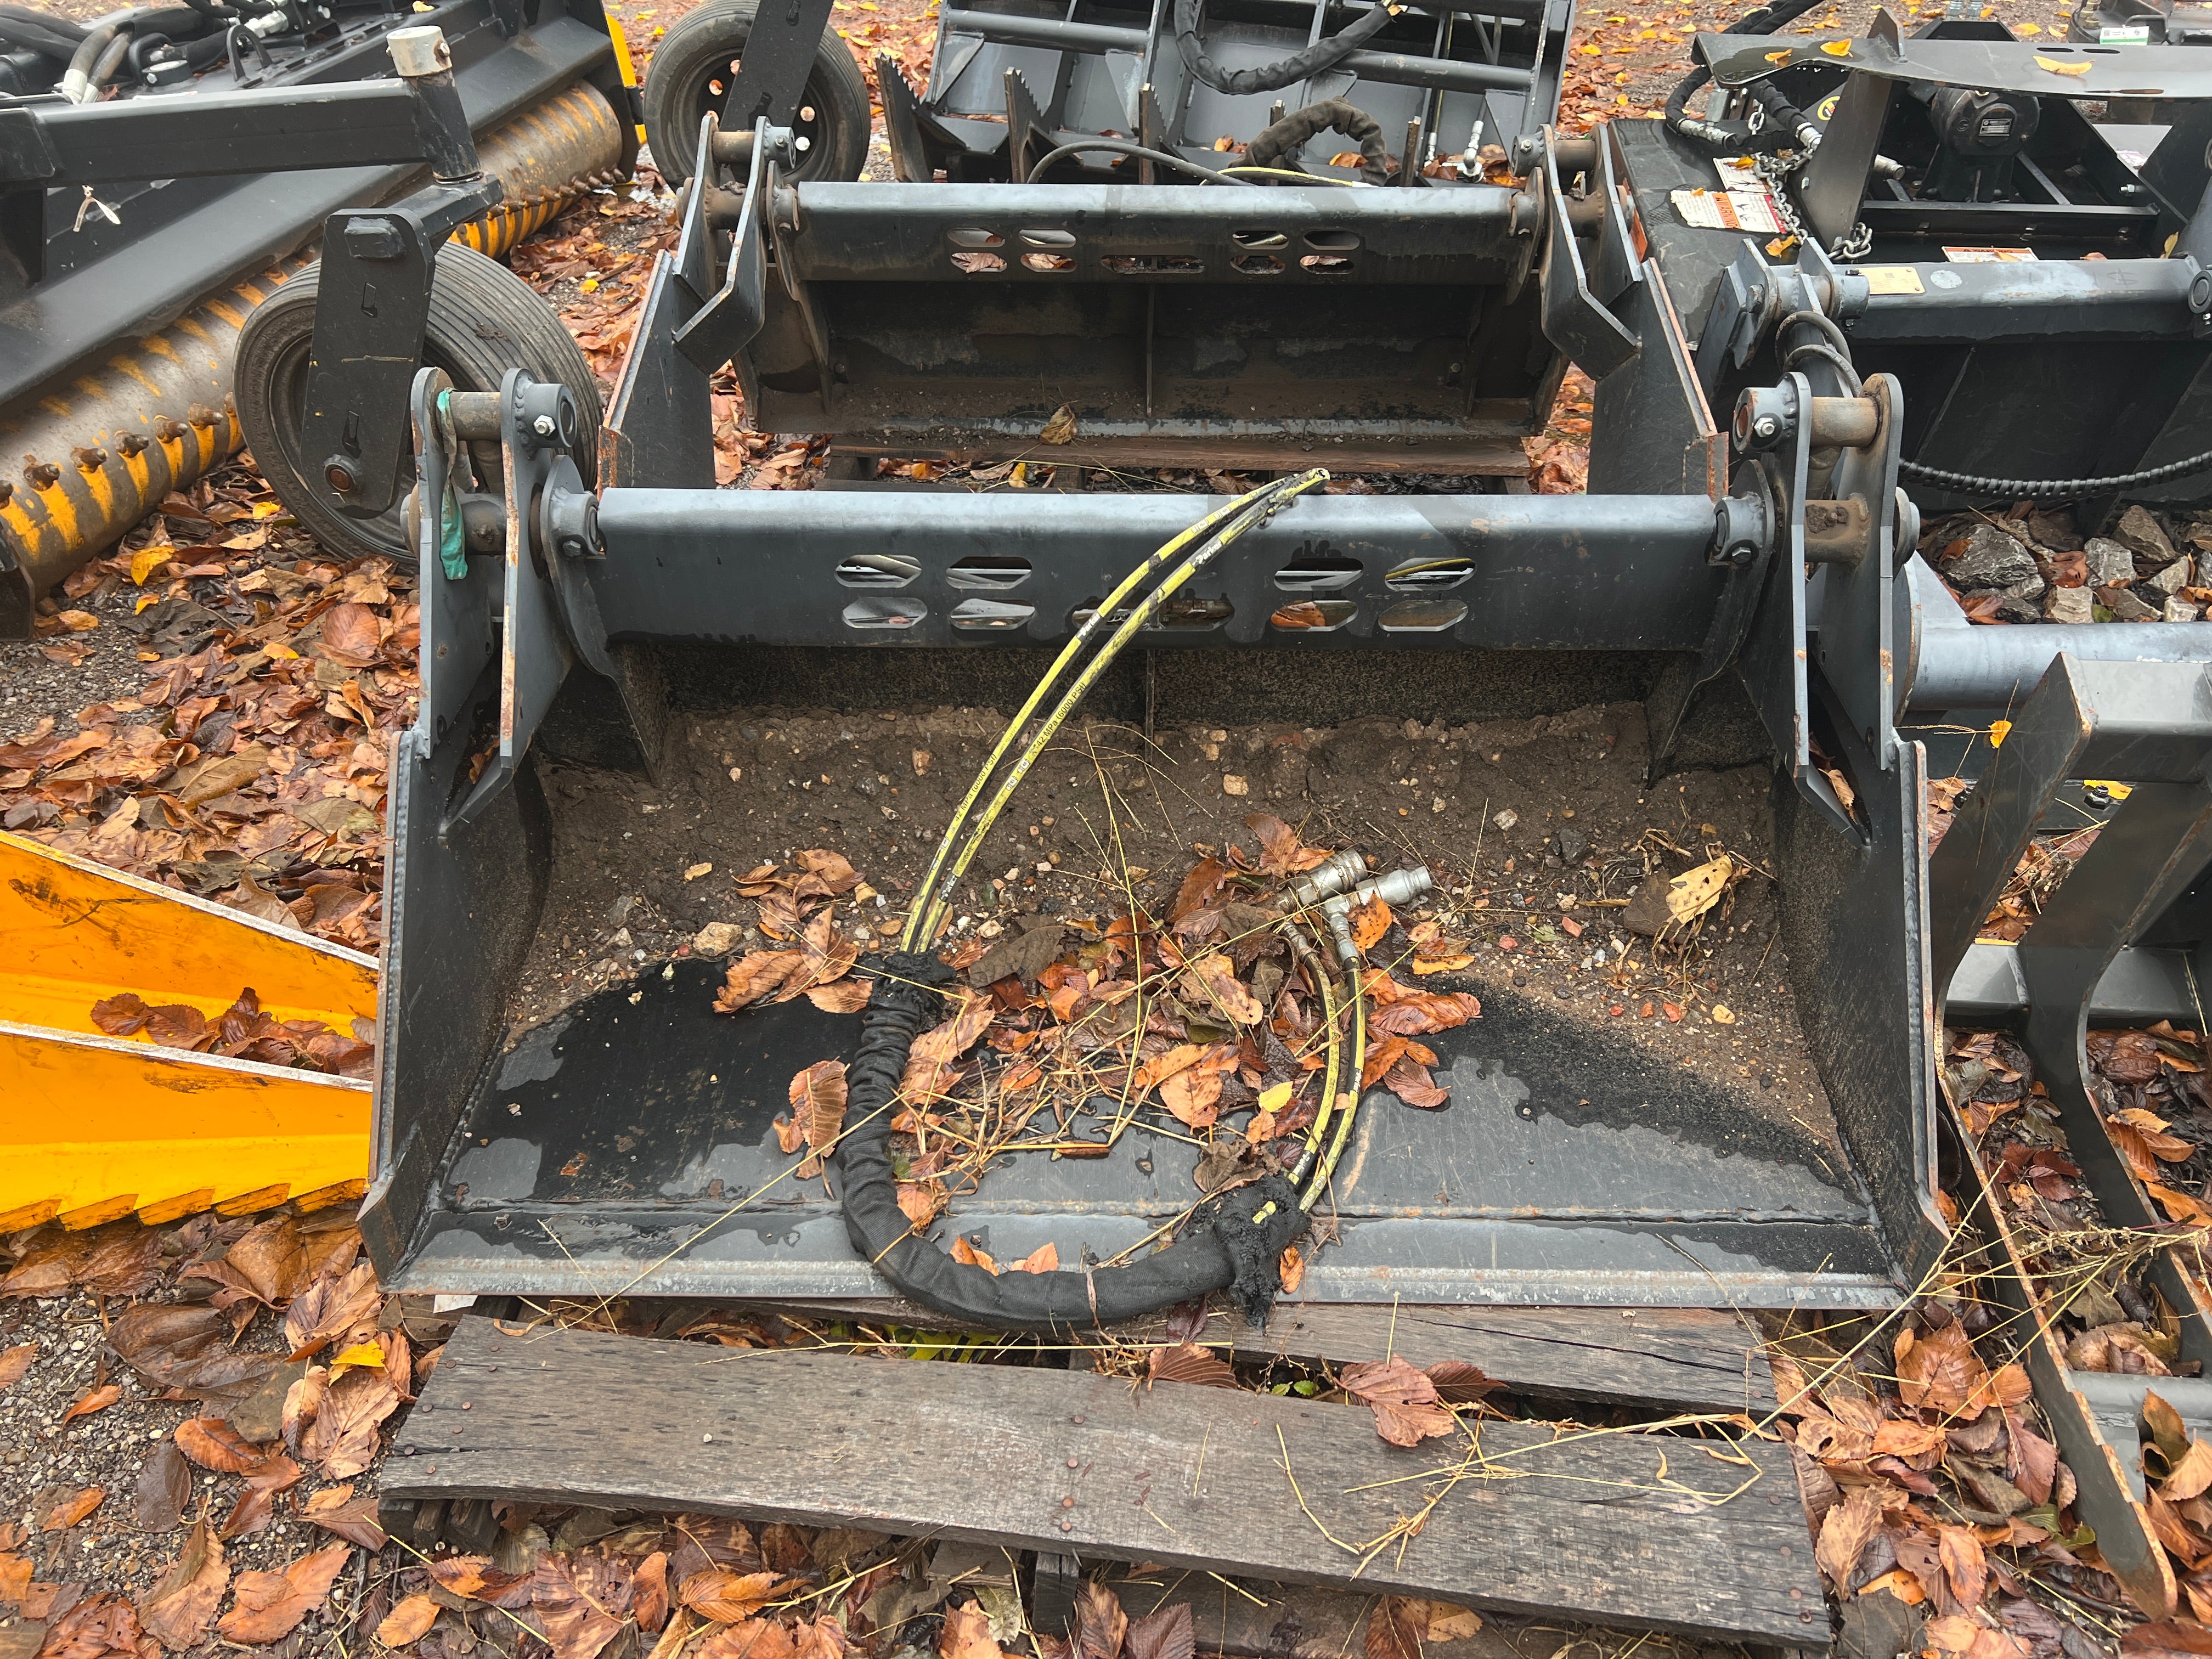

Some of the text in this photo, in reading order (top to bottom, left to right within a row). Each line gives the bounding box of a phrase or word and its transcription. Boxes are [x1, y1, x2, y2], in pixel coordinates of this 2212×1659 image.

[1717, 201, 1738, 226] WARNING
[1189, 539, 1223, 568] Parker
[1075, 612, 1102, 640] Parker
[1035, 681, 1087, 747] 42 MPa (6000 PSI)
[954, 811, 962, 822] 42
[960, 792, 973, 810] MPa
